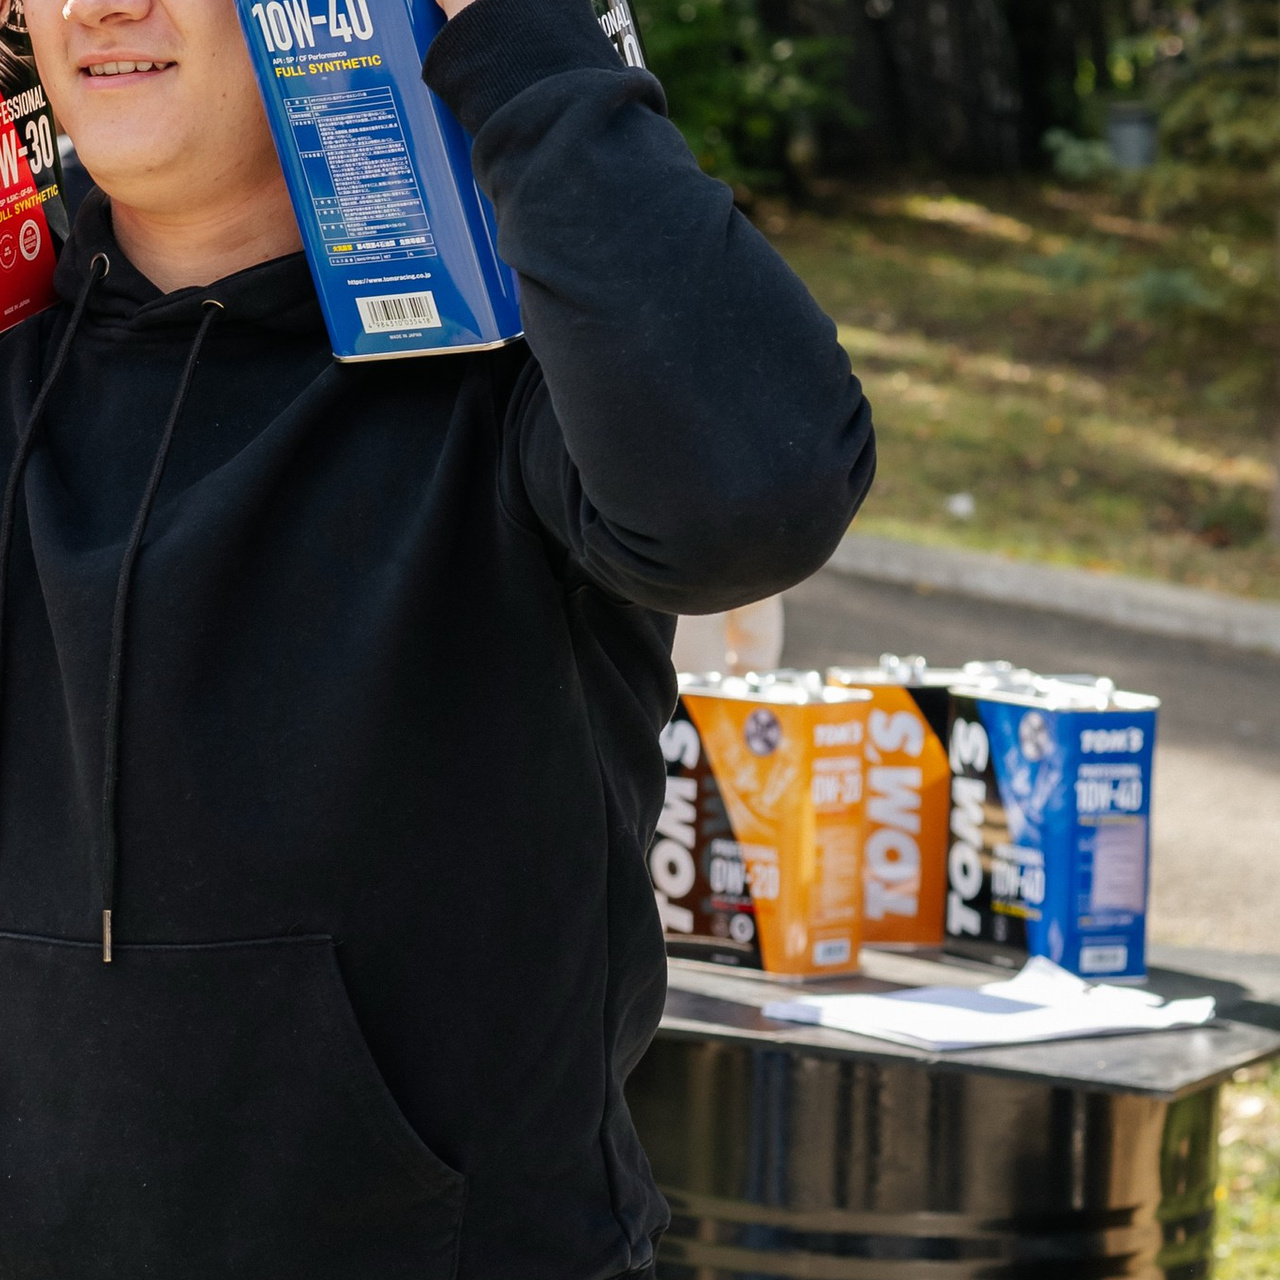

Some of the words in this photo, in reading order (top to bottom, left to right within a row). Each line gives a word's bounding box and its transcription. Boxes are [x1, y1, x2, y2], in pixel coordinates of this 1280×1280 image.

[275, 65, 306, 78] FULL
[309, 55, 382, 75] SYNTHETIC
[308, 51, 347, 61] Performance
[14, 183, 59, 215] SYNTHETIC
[347, 272, 431, 286] https://www.tomsracing.co.jp
[862, 709, 925, 920] TOM'S
